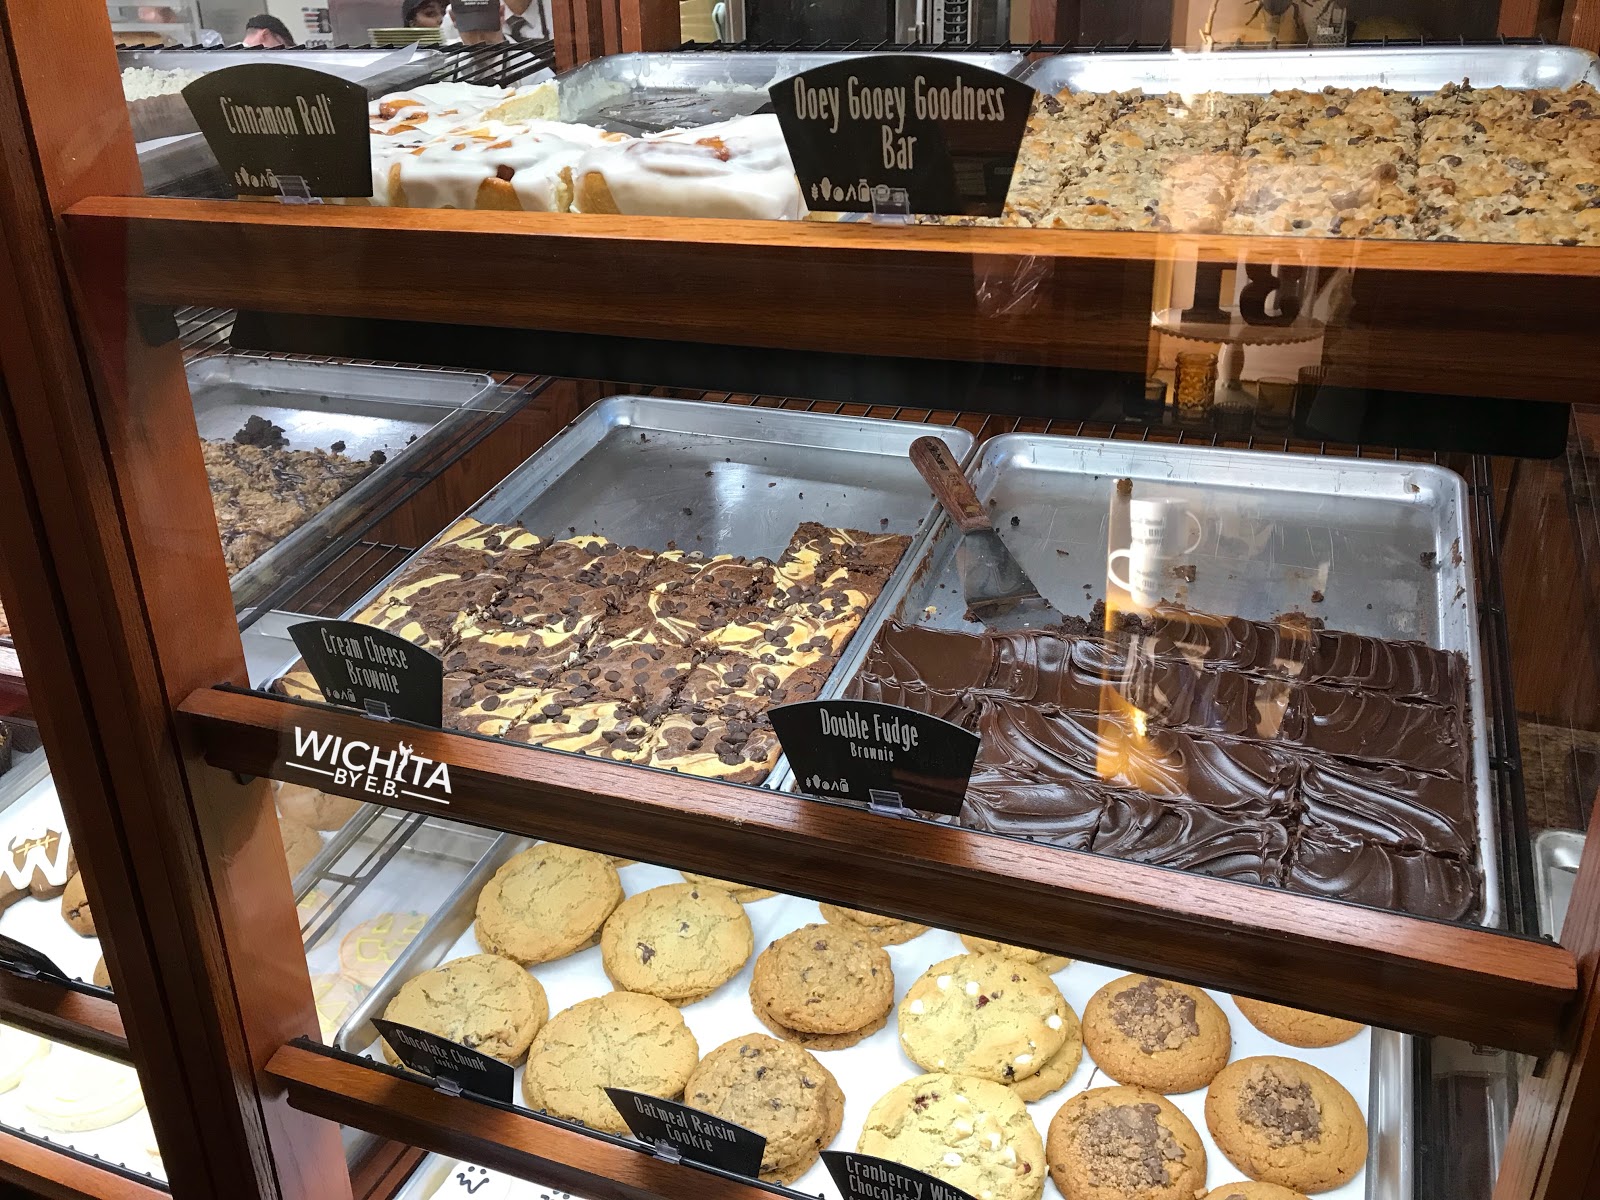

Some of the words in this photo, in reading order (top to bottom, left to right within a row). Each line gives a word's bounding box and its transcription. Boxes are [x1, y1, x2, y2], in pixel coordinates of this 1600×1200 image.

[219, 96, 299, 135] Cinnamon
[296, 93, 336, 135] Roll
[794, 76, 840, 134] Ooey
[848, 75, 906, 134] Gooey
[914, 75, 1005, 121] Goodness
[882, 124, 918, 170] Bar
[320, 627, 364, 660] Cream
[364, 635, 409, 670] Cheese
[345, 658, 400, 695] Brownie
[819, 708, 870, 741] Double
[873, 713, 919, 752] Fudge
[850, 741, 895, 763] Brownie
[395, 1028, 449, 1061] Chocolate
[450, 1048, 488, 1073] Chunk
[633, 1095, 689, 1129] Oatmeal
[691, 1114, 737, 1143] Raisin
[665, 1123, 714, 1153] Cookie
[845, 1154, 923, 1200] Cranberry
